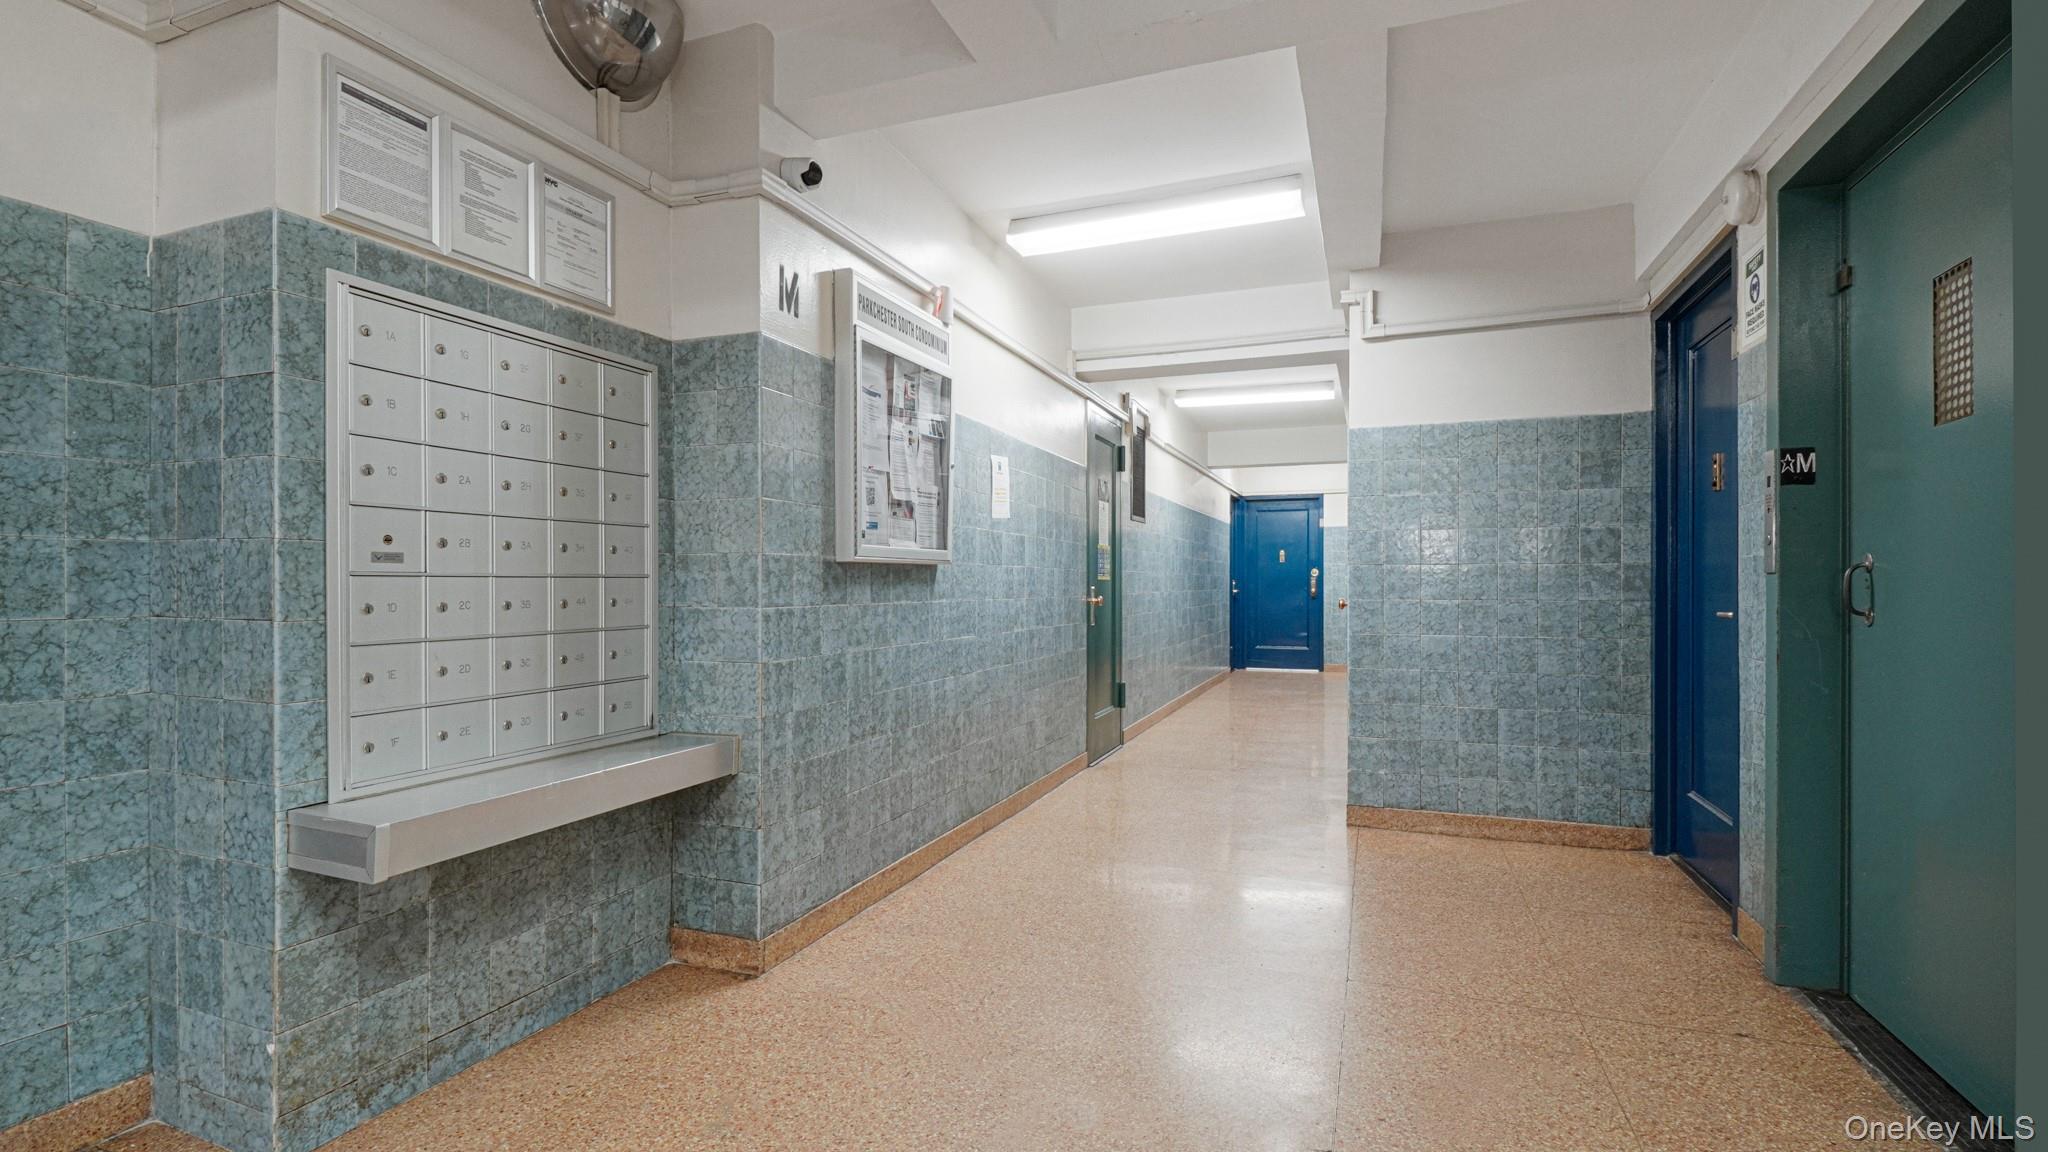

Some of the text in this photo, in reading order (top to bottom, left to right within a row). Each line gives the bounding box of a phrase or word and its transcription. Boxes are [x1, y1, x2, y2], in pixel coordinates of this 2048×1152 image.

[779, 263, 799, 319] M
[858, 293, 947, 355] PARKCHESTER SOUTH CONDOMINIUM
[386, 330, 396, 342] 1A
[386, 399, 396, 409] 1B
[520, 423, 531, 433] 2G
[1796, 452, 1816, 473] M
[387, 466, 398, 477] 1C
[458, 475, 471, 485] 2A
[458, 538, 471, 548] 2B
[387, 602, 398, 613] 1D
[458, 600, 471, 610] 2C
[458, 664, 471, 674] 2D
[459, 726, 471, 736] 2E
